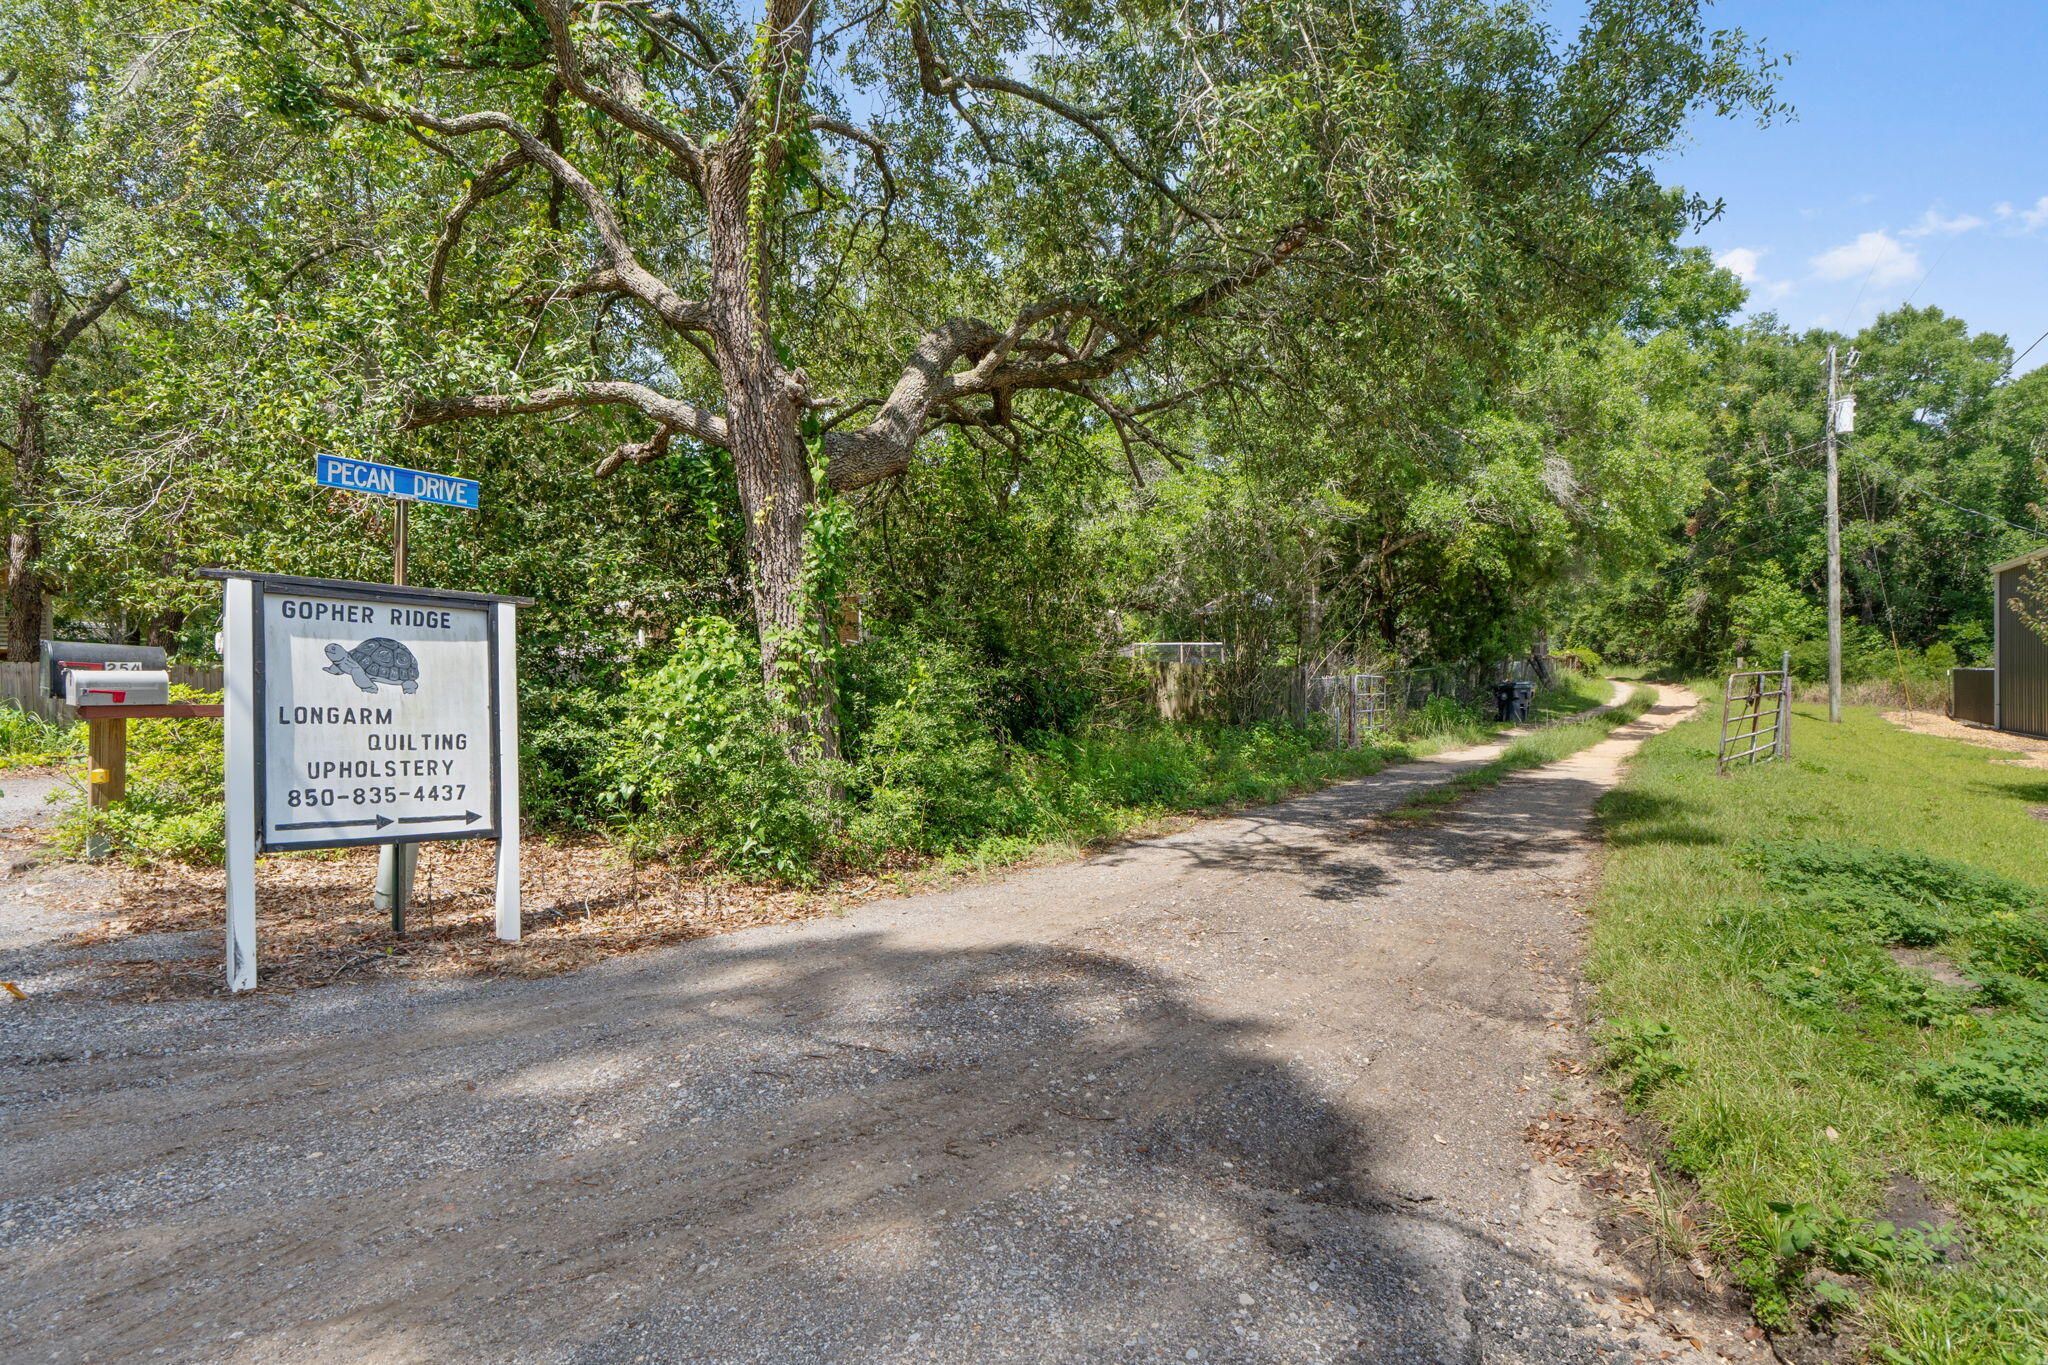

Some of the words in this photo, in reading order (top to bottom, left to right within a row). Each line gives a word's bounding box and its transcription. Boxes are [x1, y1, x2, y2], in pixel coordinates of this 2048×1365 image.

[327, 460, 395, 492] PECAN
[413, 474, 468, 503] DRIVE
[282, 600, 374, 624] GOPHER
[390, 608, 451, 629] RIDGE
[107, 663, 140, 671] 254
[279, 706, 393, 725] LONGARM
[368, 733, 467, 751] QUILTING
[307, 759, 454, 780] UPHOLSTERY
[287, 784, 466, 807] 850-835-4437
